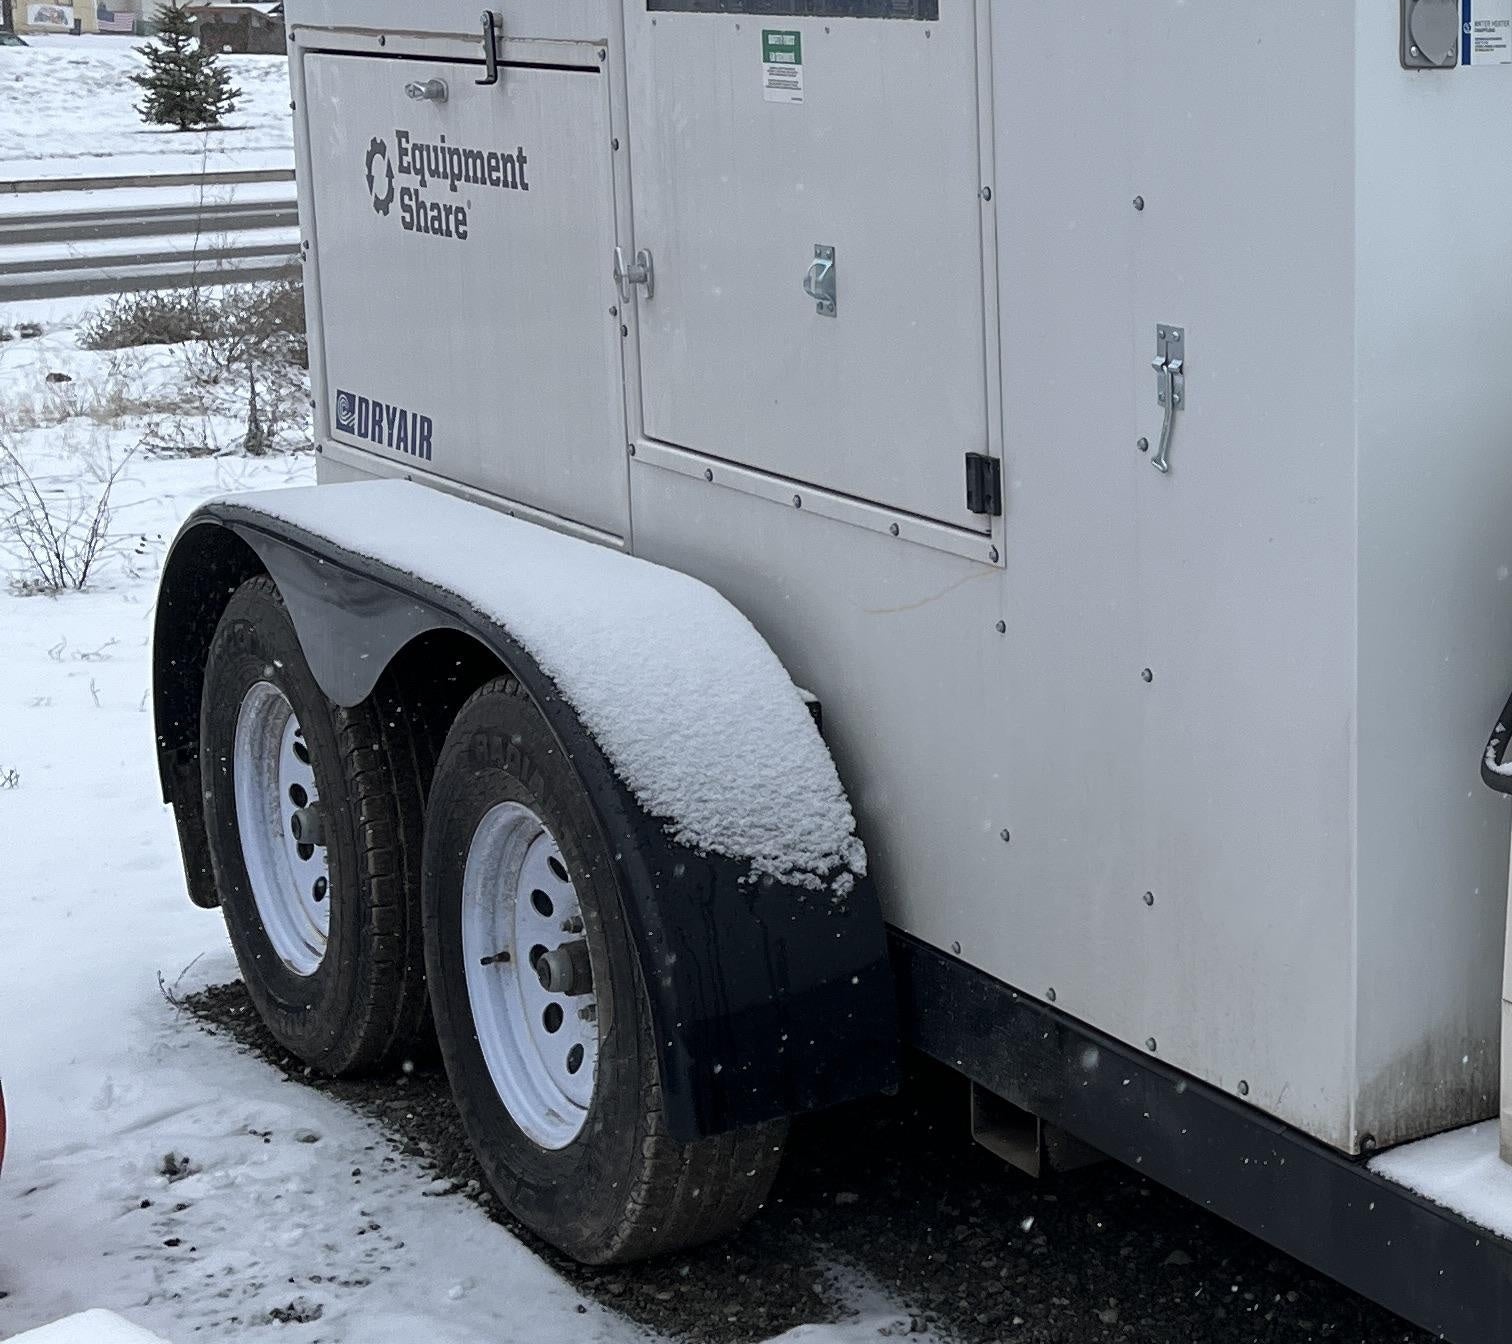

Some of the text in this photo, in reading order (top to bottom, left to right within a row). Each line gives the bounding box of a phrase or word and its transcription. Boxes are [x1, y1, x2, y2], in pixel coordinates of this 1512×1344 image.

[395, 129, 529, 193] Equipment
[400, 186, 468, 241] Share
[357, 396, 433, 461] DRYAIR
